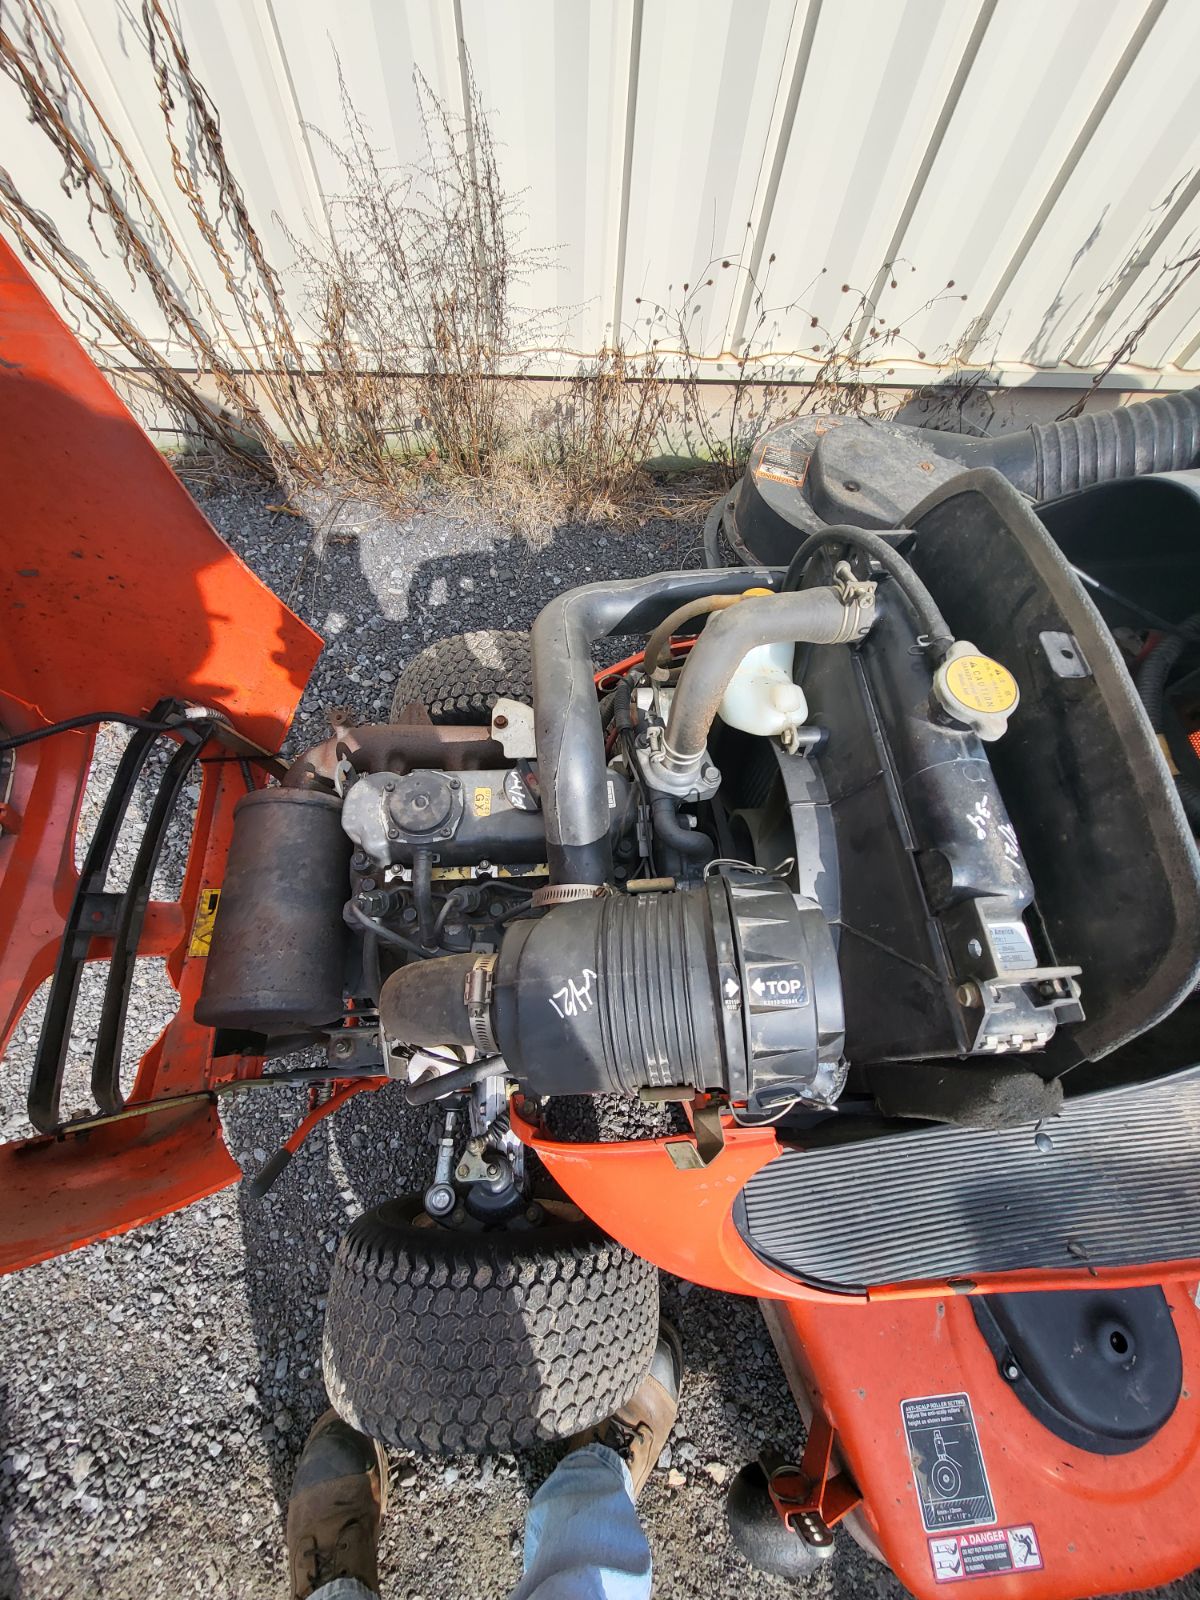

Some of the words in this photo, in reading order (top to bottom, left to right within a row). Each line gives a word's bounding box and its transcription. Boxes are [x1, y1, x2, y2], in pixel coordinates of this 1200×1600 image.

[972, 670, 994, 707] CAUTION
[766, 980, 801, 995] TOP
[968, 1530, 1006, 1545] DANGER
